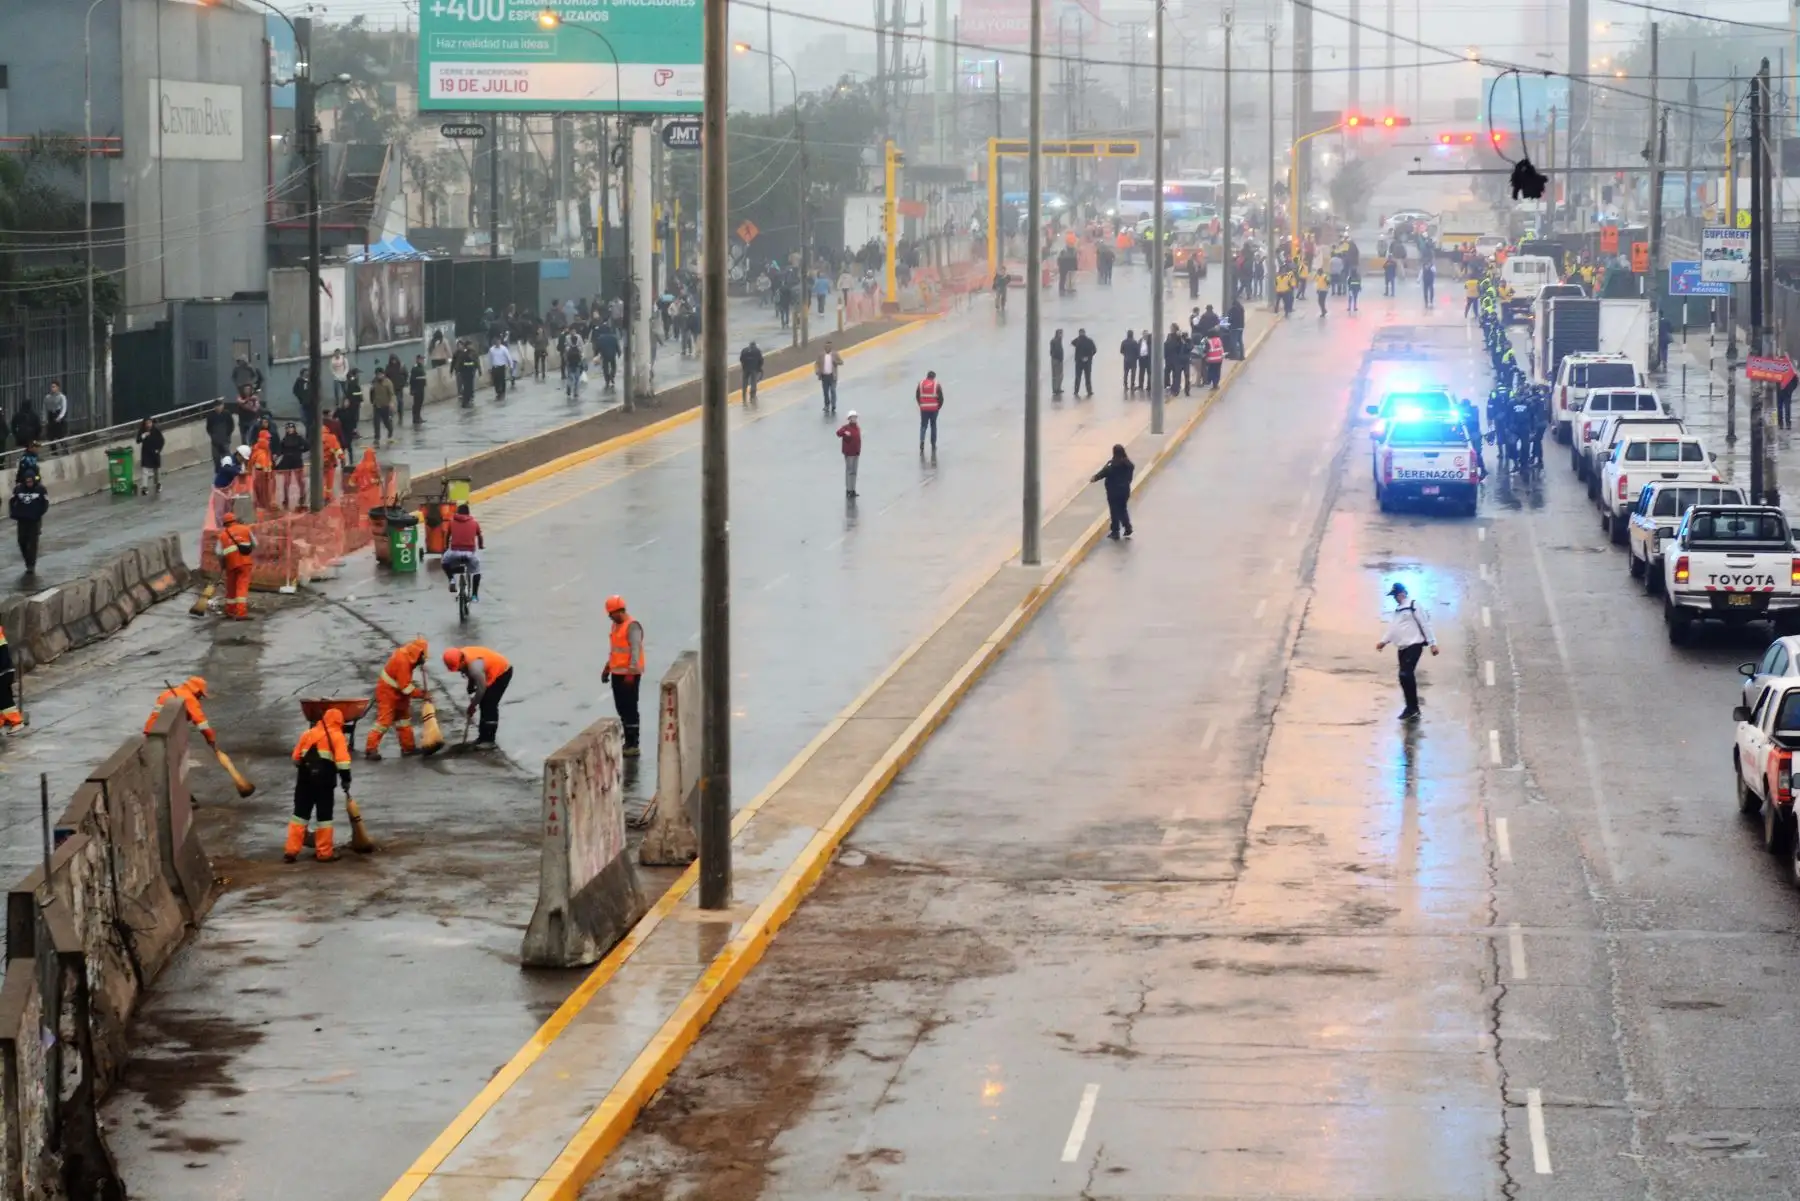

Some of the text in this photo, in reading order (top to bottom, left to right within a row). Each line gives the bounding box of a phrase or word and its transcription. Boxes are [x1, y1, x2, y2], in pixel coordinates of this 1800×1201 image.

[430, 0, 505, 21] +400
[436, 37, 456, 49] Haz
[440, 78, 529, 94] 19 DE JULIO
[669, 126, 700, 141] JMT
[1398, 469, 1465, 479] SERENAZGO
[1708, 573, 1776, 586] TOYOTA
